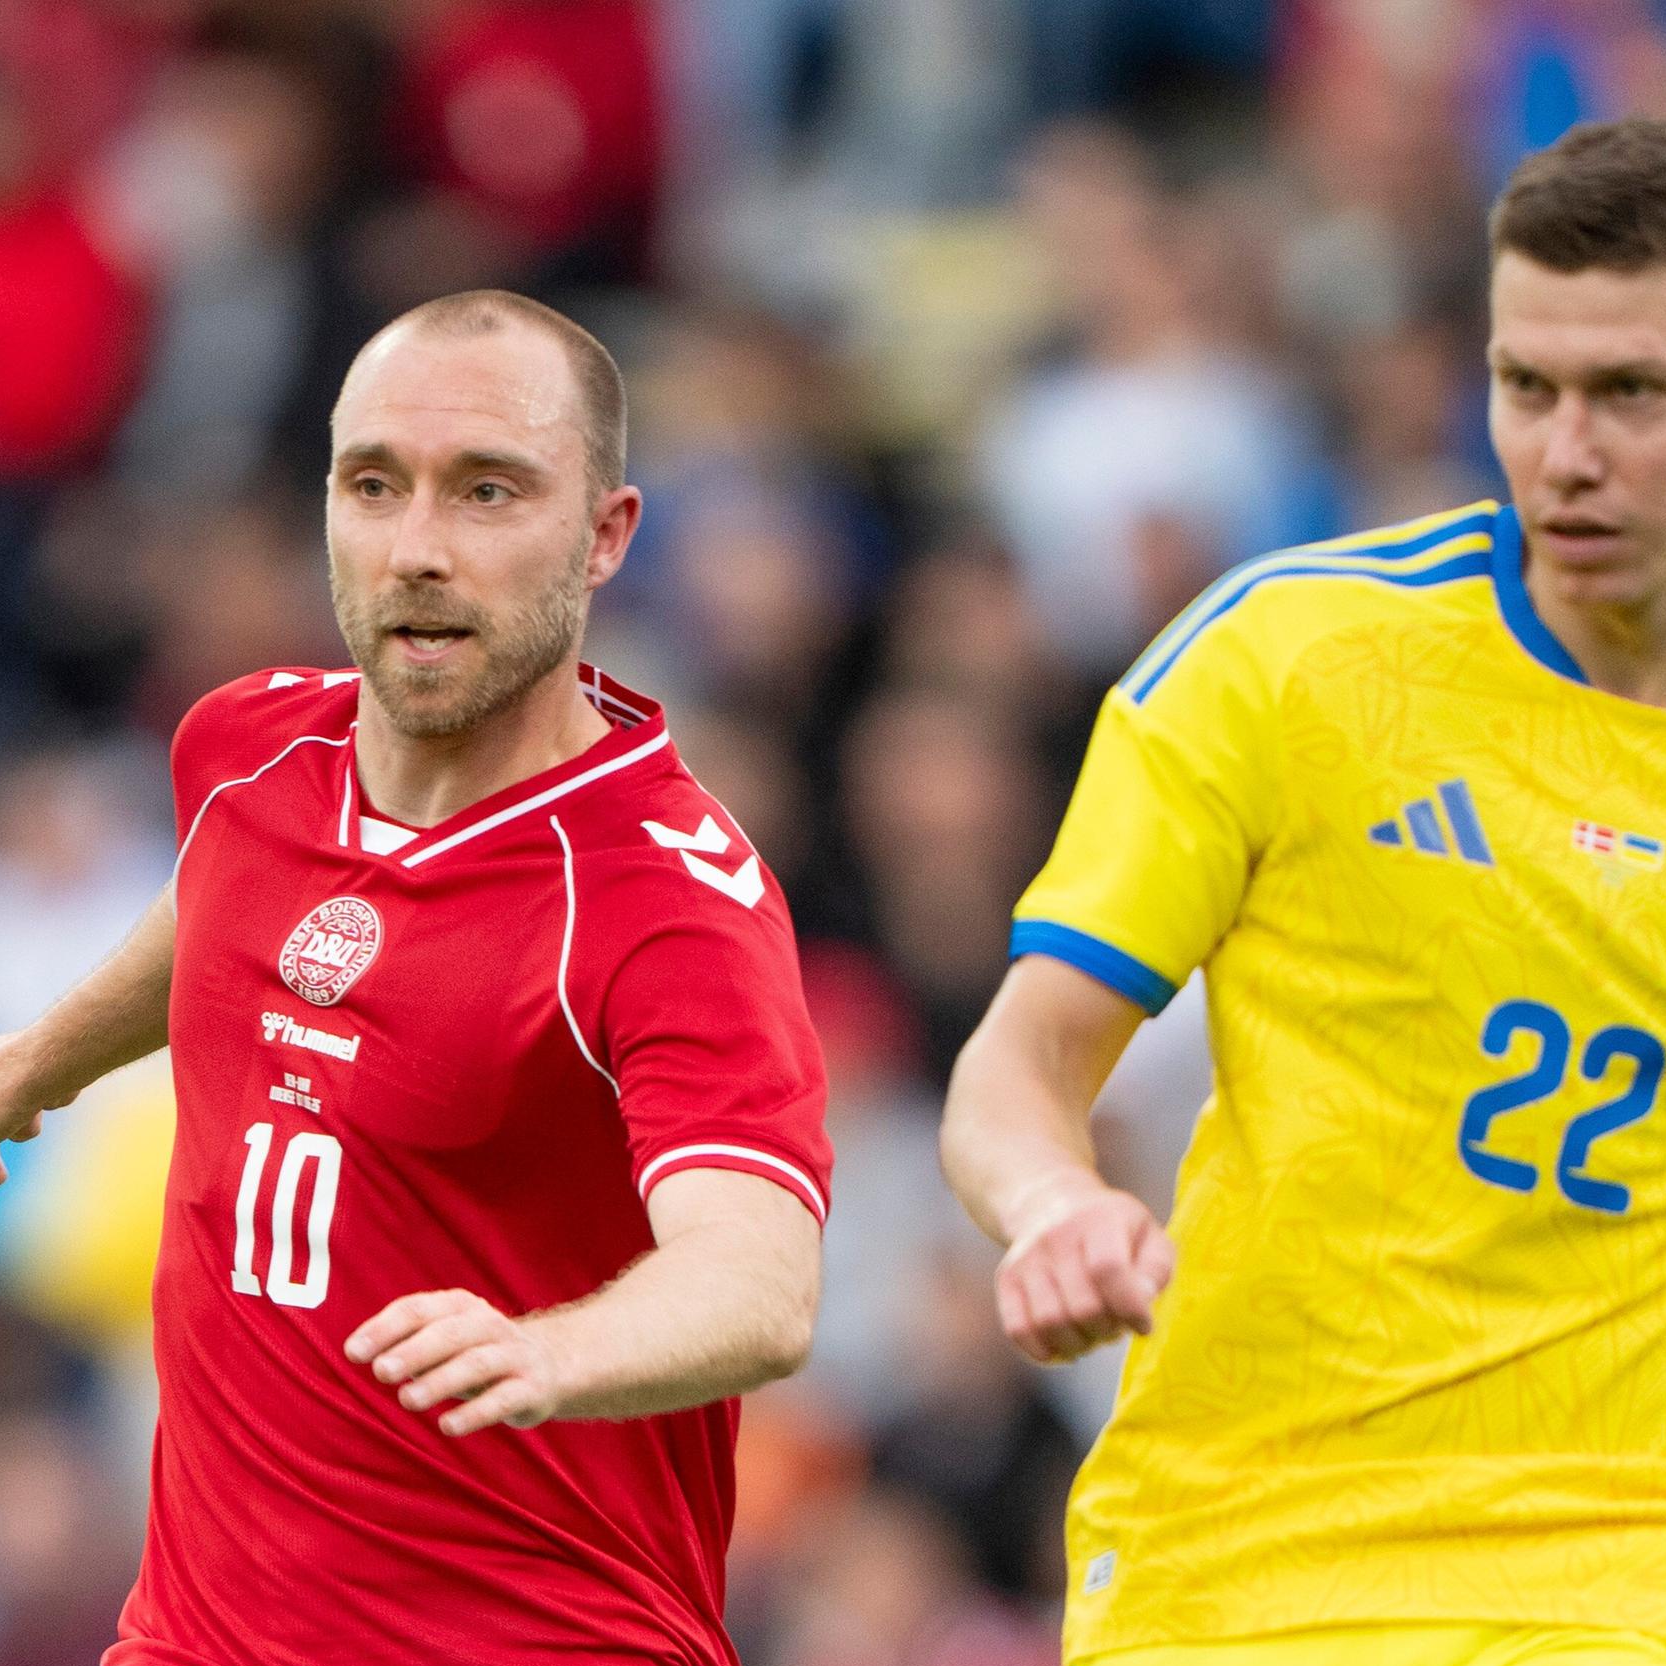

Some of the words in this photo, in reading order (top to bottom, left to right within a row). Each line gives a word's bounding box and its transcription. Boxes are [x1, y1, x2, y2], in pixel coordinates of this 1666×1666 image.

[283, 920, 316, 983] DANSK
[297, 983, 331, 1002] 1889
[281, 1017, 361, 1062] hummel
[1456, 997, 1666, 1214] 22
[230, 1121, 343, 1310] 10
